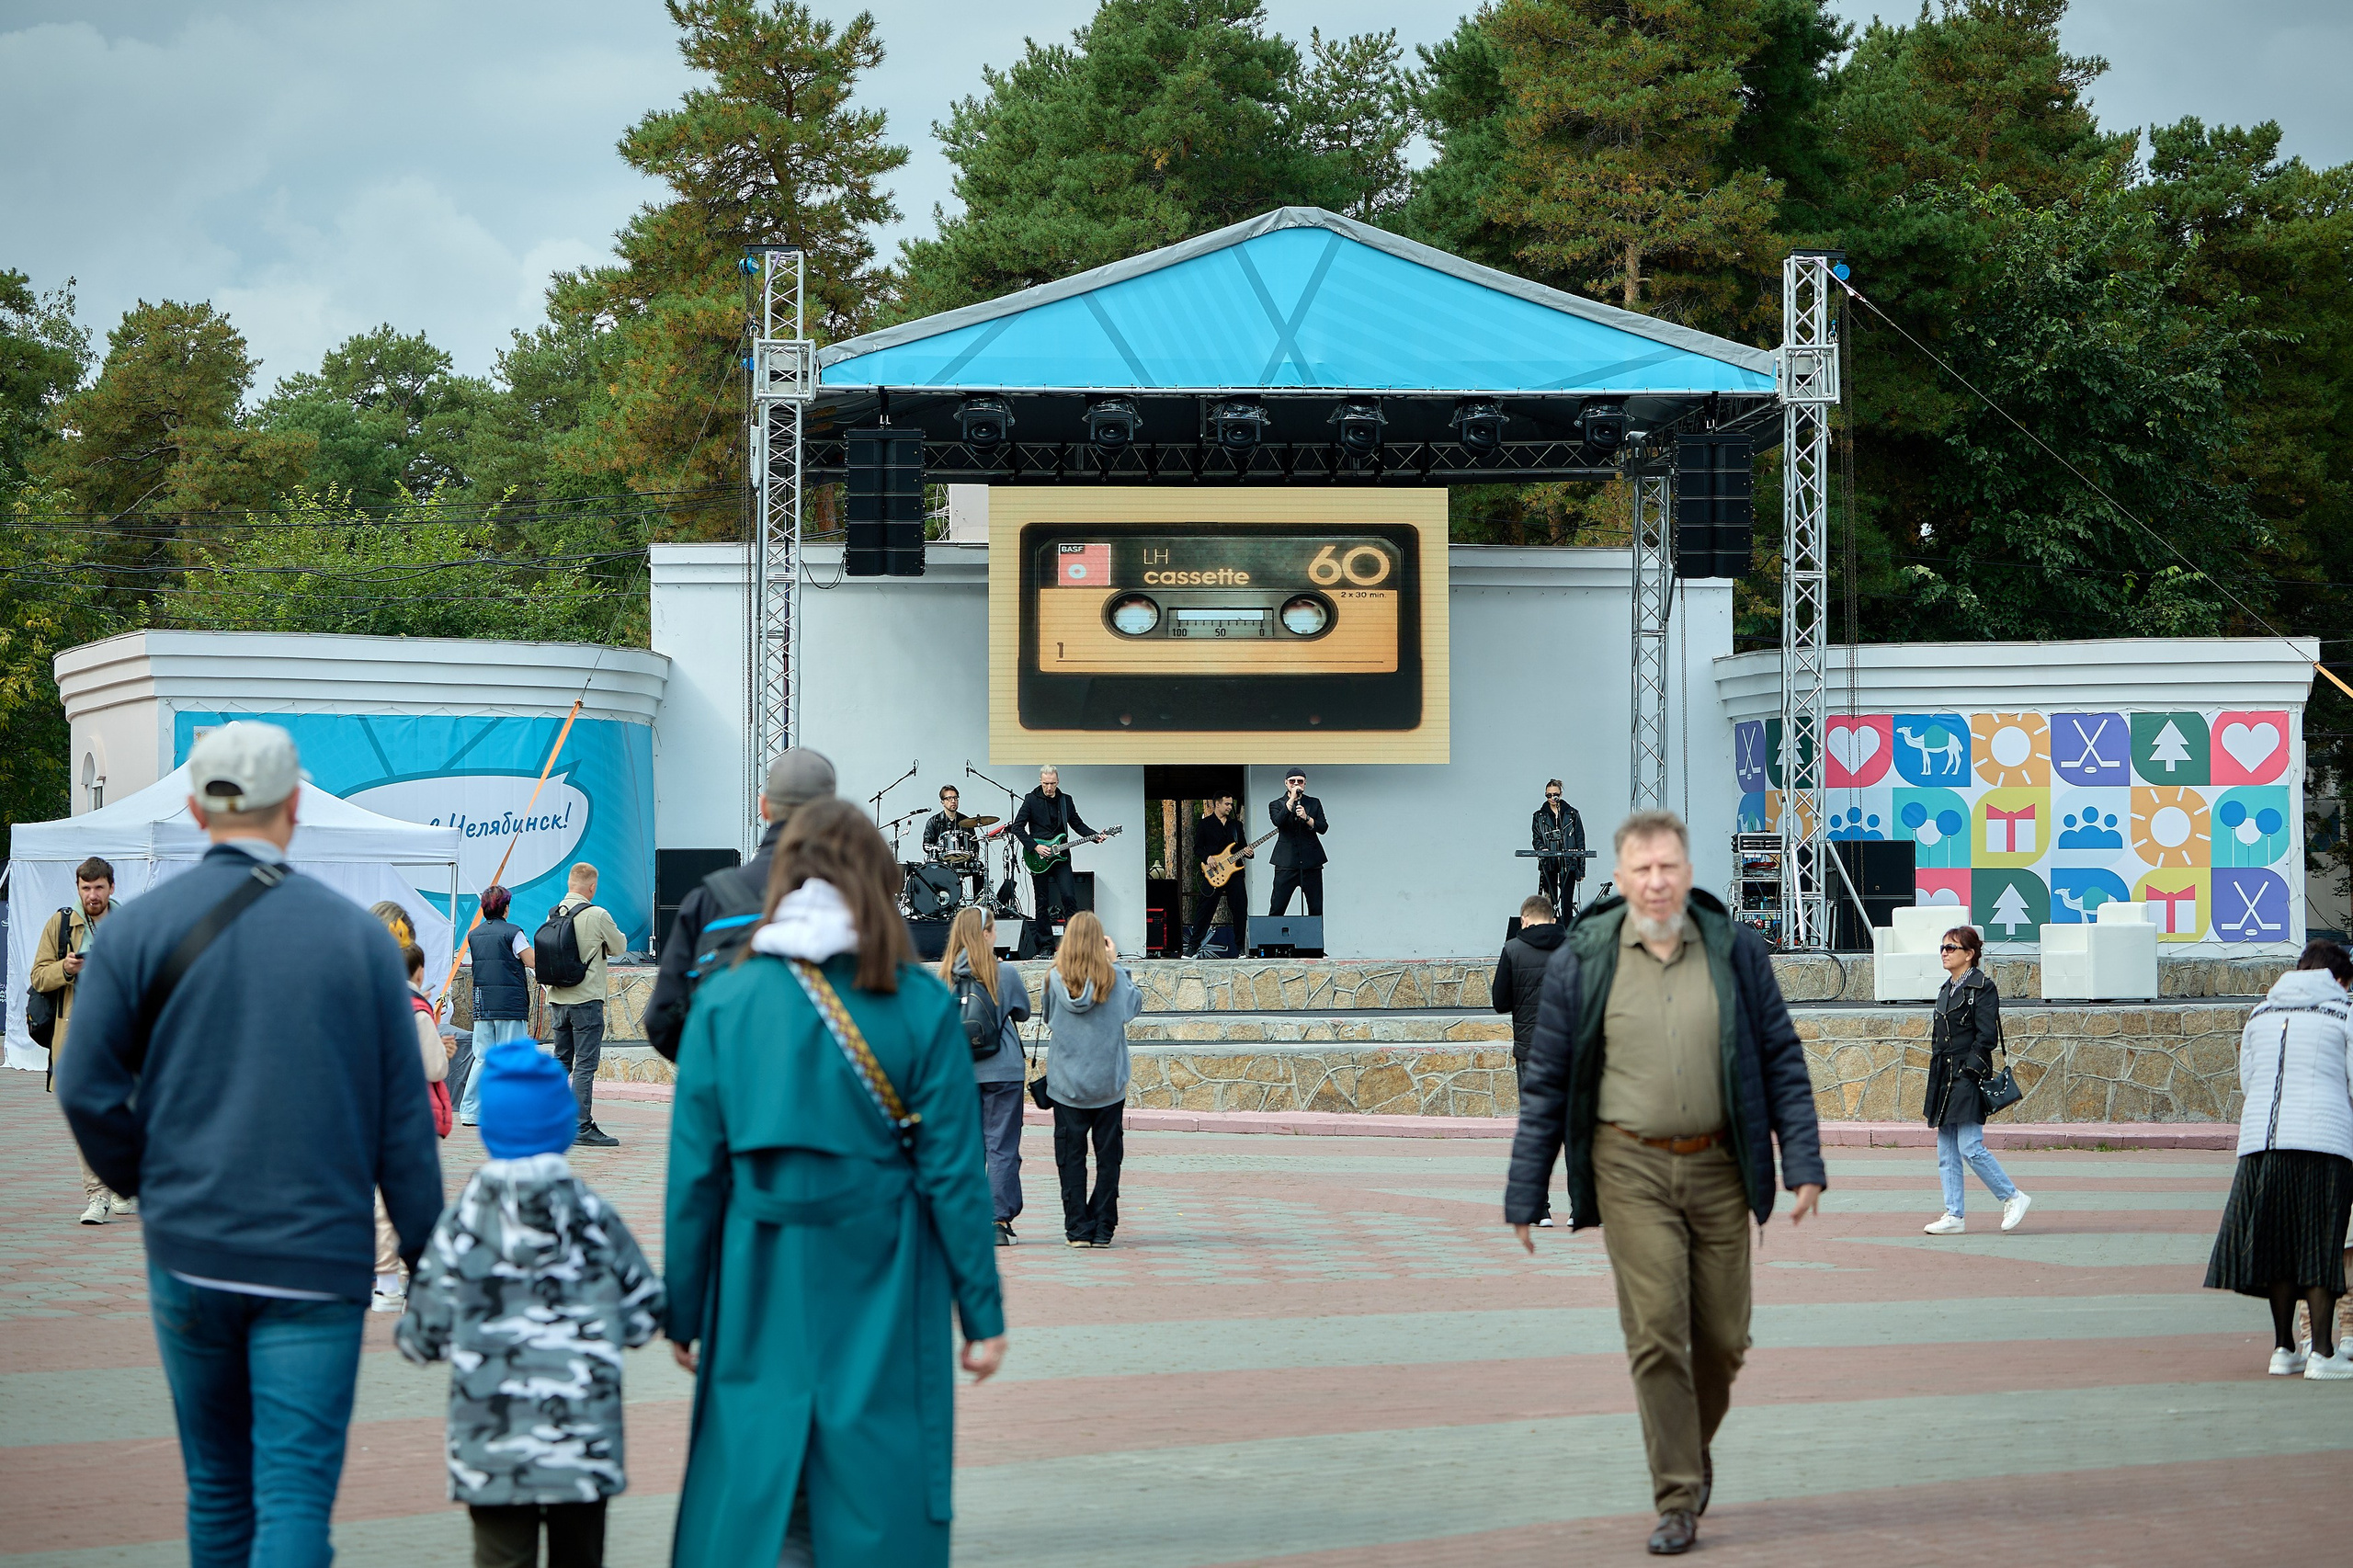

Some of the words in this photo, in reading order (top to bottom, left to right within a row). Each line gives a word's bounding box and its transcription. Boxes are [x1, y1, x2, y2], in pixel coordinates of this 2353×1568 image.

[1143, 548, 1168, 564] LH
[1308, 545, 1391, 586] 60
[1143, 568, 1250, 585] cassette
[1172, 628, 1188, 637] 100
[1215, 628, 1226, 637] 50
[1259, 628, 1265, 637] 0
[1056, 642, 1064, 659] 1
